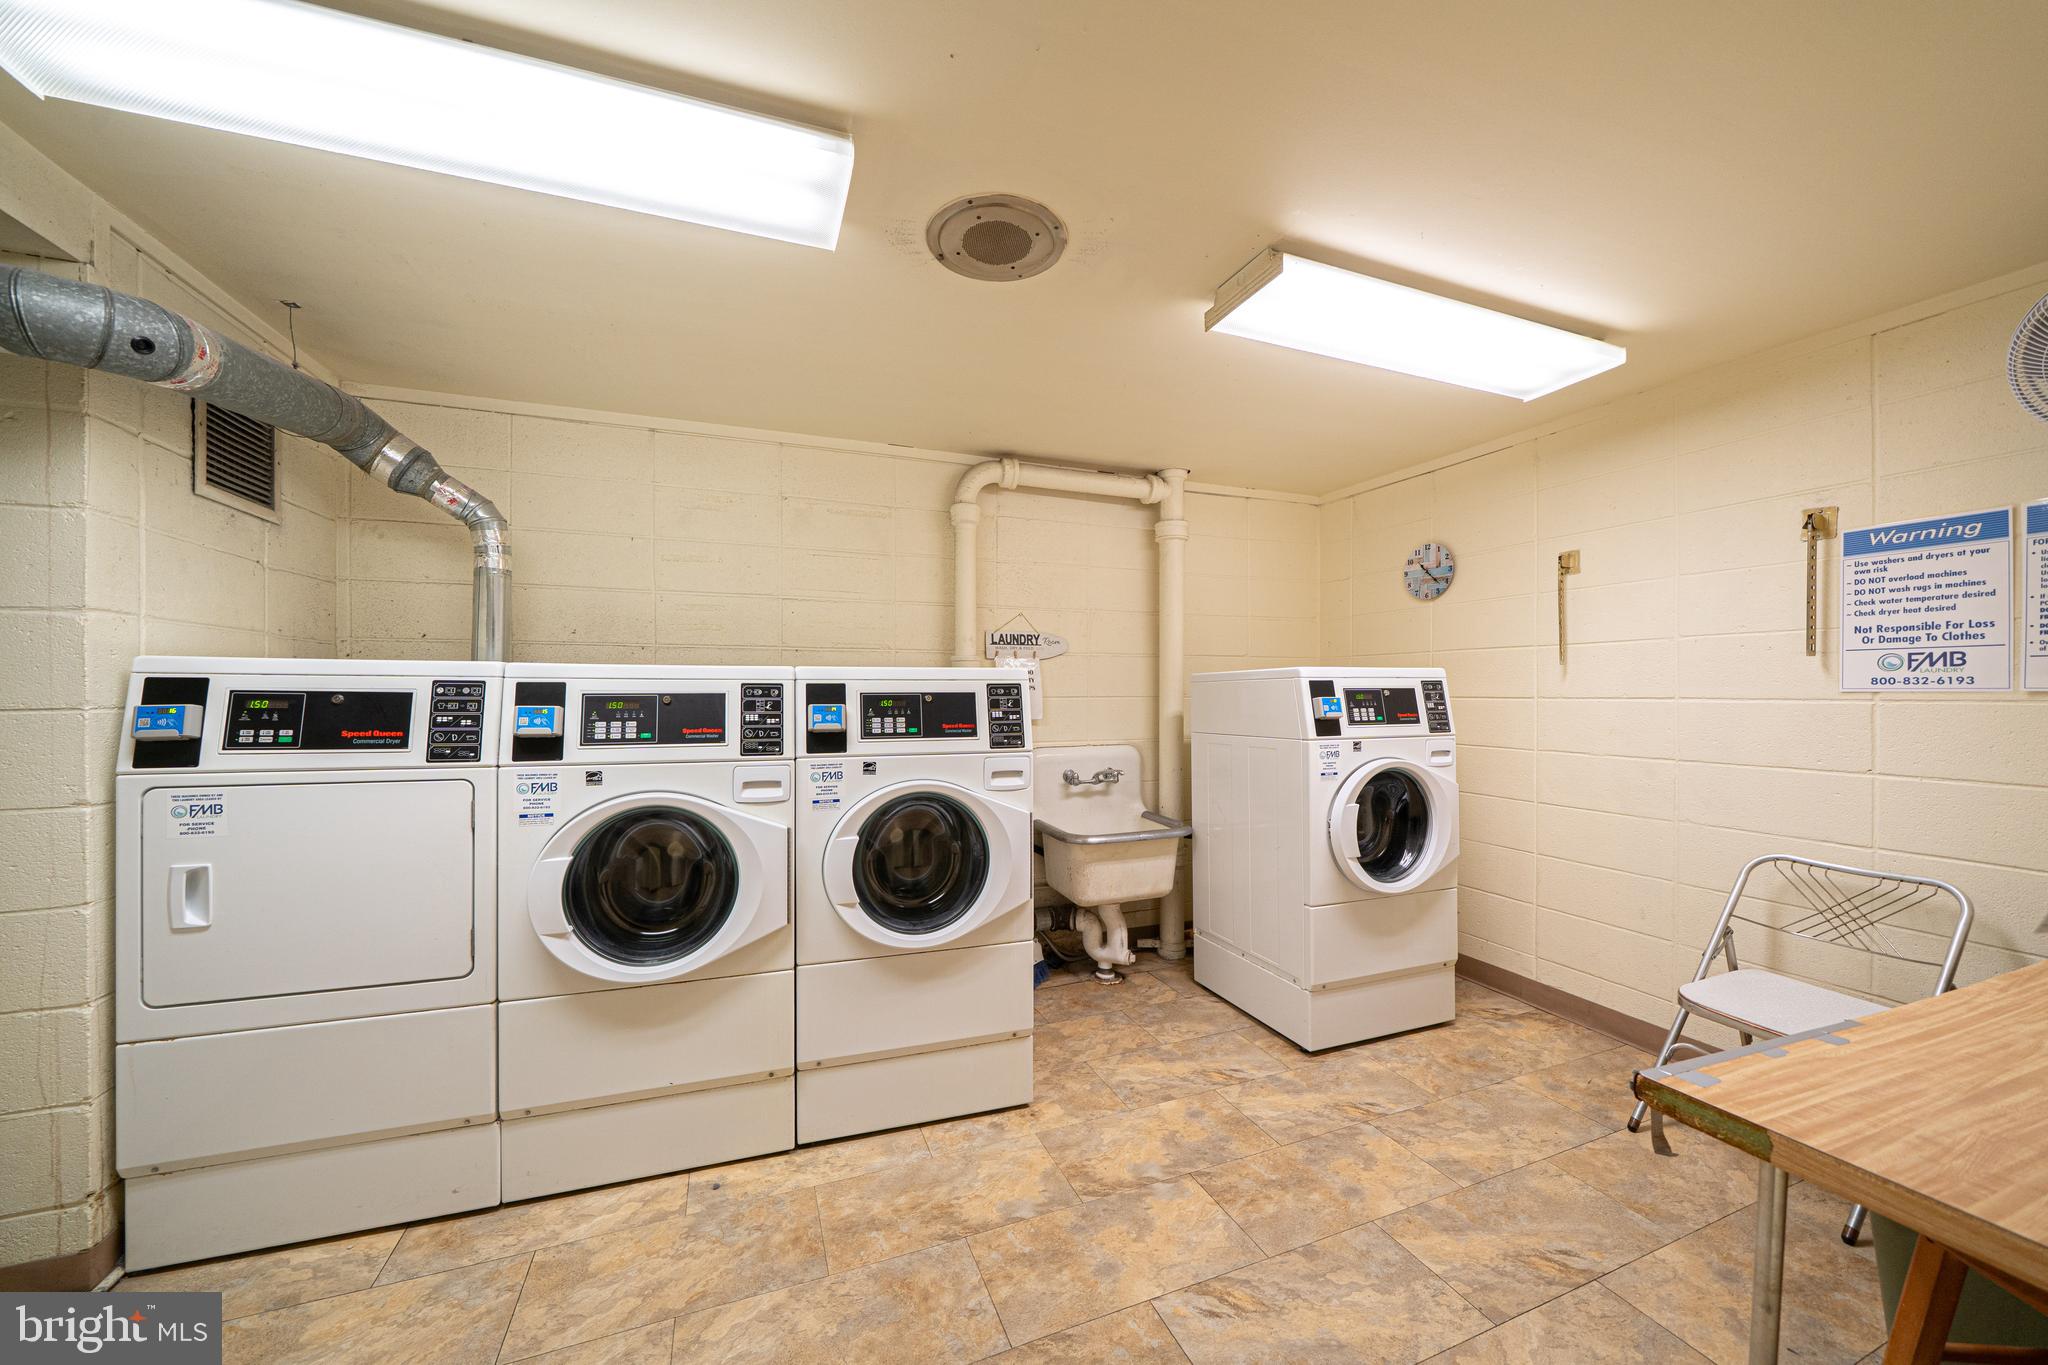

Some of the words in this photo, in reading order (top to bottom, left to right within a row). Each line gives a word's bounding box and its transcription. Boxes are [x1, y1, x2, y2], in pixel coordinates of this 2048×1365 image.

[1869, 522, 1983, 546] Warning
[1871, 557, 1905, 566] washers
[1907, 553, 1923, 562] and
[1925, 552, 1954, 560] dryers
[1957, 549, 1966, 557] at
[1969, 547, 1991, 557] your
[1873, 565, 1888, 574] risk
[1854, 578, 1866, 586] DO
[1868, 576, 1886, 584] NOT
[1888, 572, 1925, 583] overload
[1927, 569, 1968, 579] machines
[1854, 588, 1866, 596] DO
[1868, 587, 1886, 595] NOT
[1888, 585, 1911, 593] wash
[1913, 584, 1932, 593] rugs
[1945, 579, 1987, 589] machines
[1854, 598, 1876, 606] Check
[1879, 597, 1903, 605] water
[1905, 593, 1960, 604] temperature
[1962, 589, 1997, 599] desired
[1854, 609, 1876, 617] Check
[1878, 608, 1901, 617] dryer
[1903, 606, 1922, 614] heat
[1924, 603, 1957, 613] desired
[1854, 625, 1872, 634] Not
[1876, 621, 1942, 635] Responsible
[1945, 620, 1965, 630] For
[1968, 619, 1996, 629] Loss
[990, 633, 1041, 646] LAUNDRY
[1042, 636, 1061, 646] Room
[1861, 635, 1875, 645] Or
[1878, 635, 1922, 645] Damage
[1925, 632, 1938, 642] To
[1942, 630, 1986, 641] Clothes
[1907, 651, 1967, 672] FMB
[1870, 676, 1975, 686] 800-832-6193
[341, 730, 372, 738] Speed
[373, 729, 404, 737] Queen
[682, 727, 701, 735] Speed
[821, 770, 844, 783] FMB
[530, 782, 558, 795] FMB
[189, 803, 224, 819] FMB
